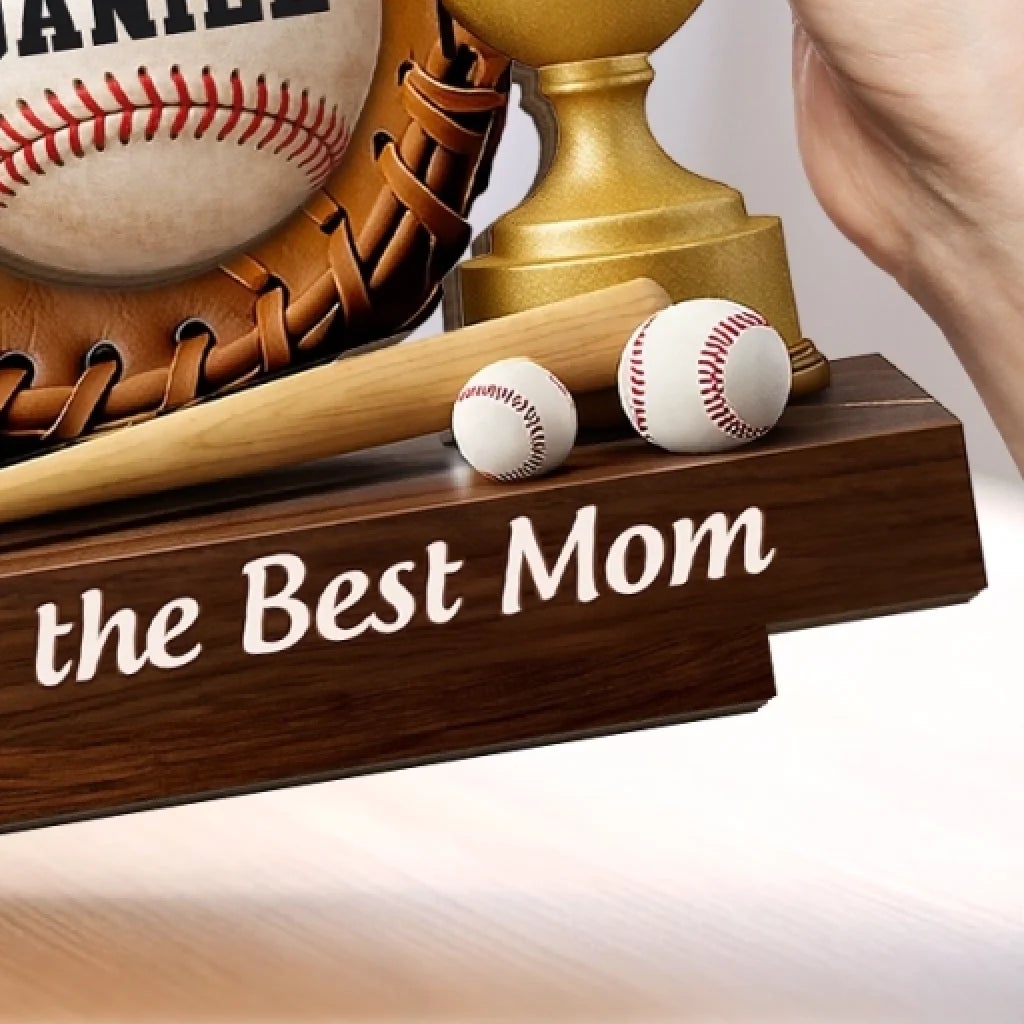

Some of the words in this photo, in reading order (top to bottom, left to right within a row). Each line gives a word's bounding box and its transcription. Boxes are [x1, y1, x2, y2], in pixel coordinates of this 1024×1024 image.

[35, 589, 201, 687] the
[243, 541, 463, 655] Best
[501, 505, 775, 615] Mom
